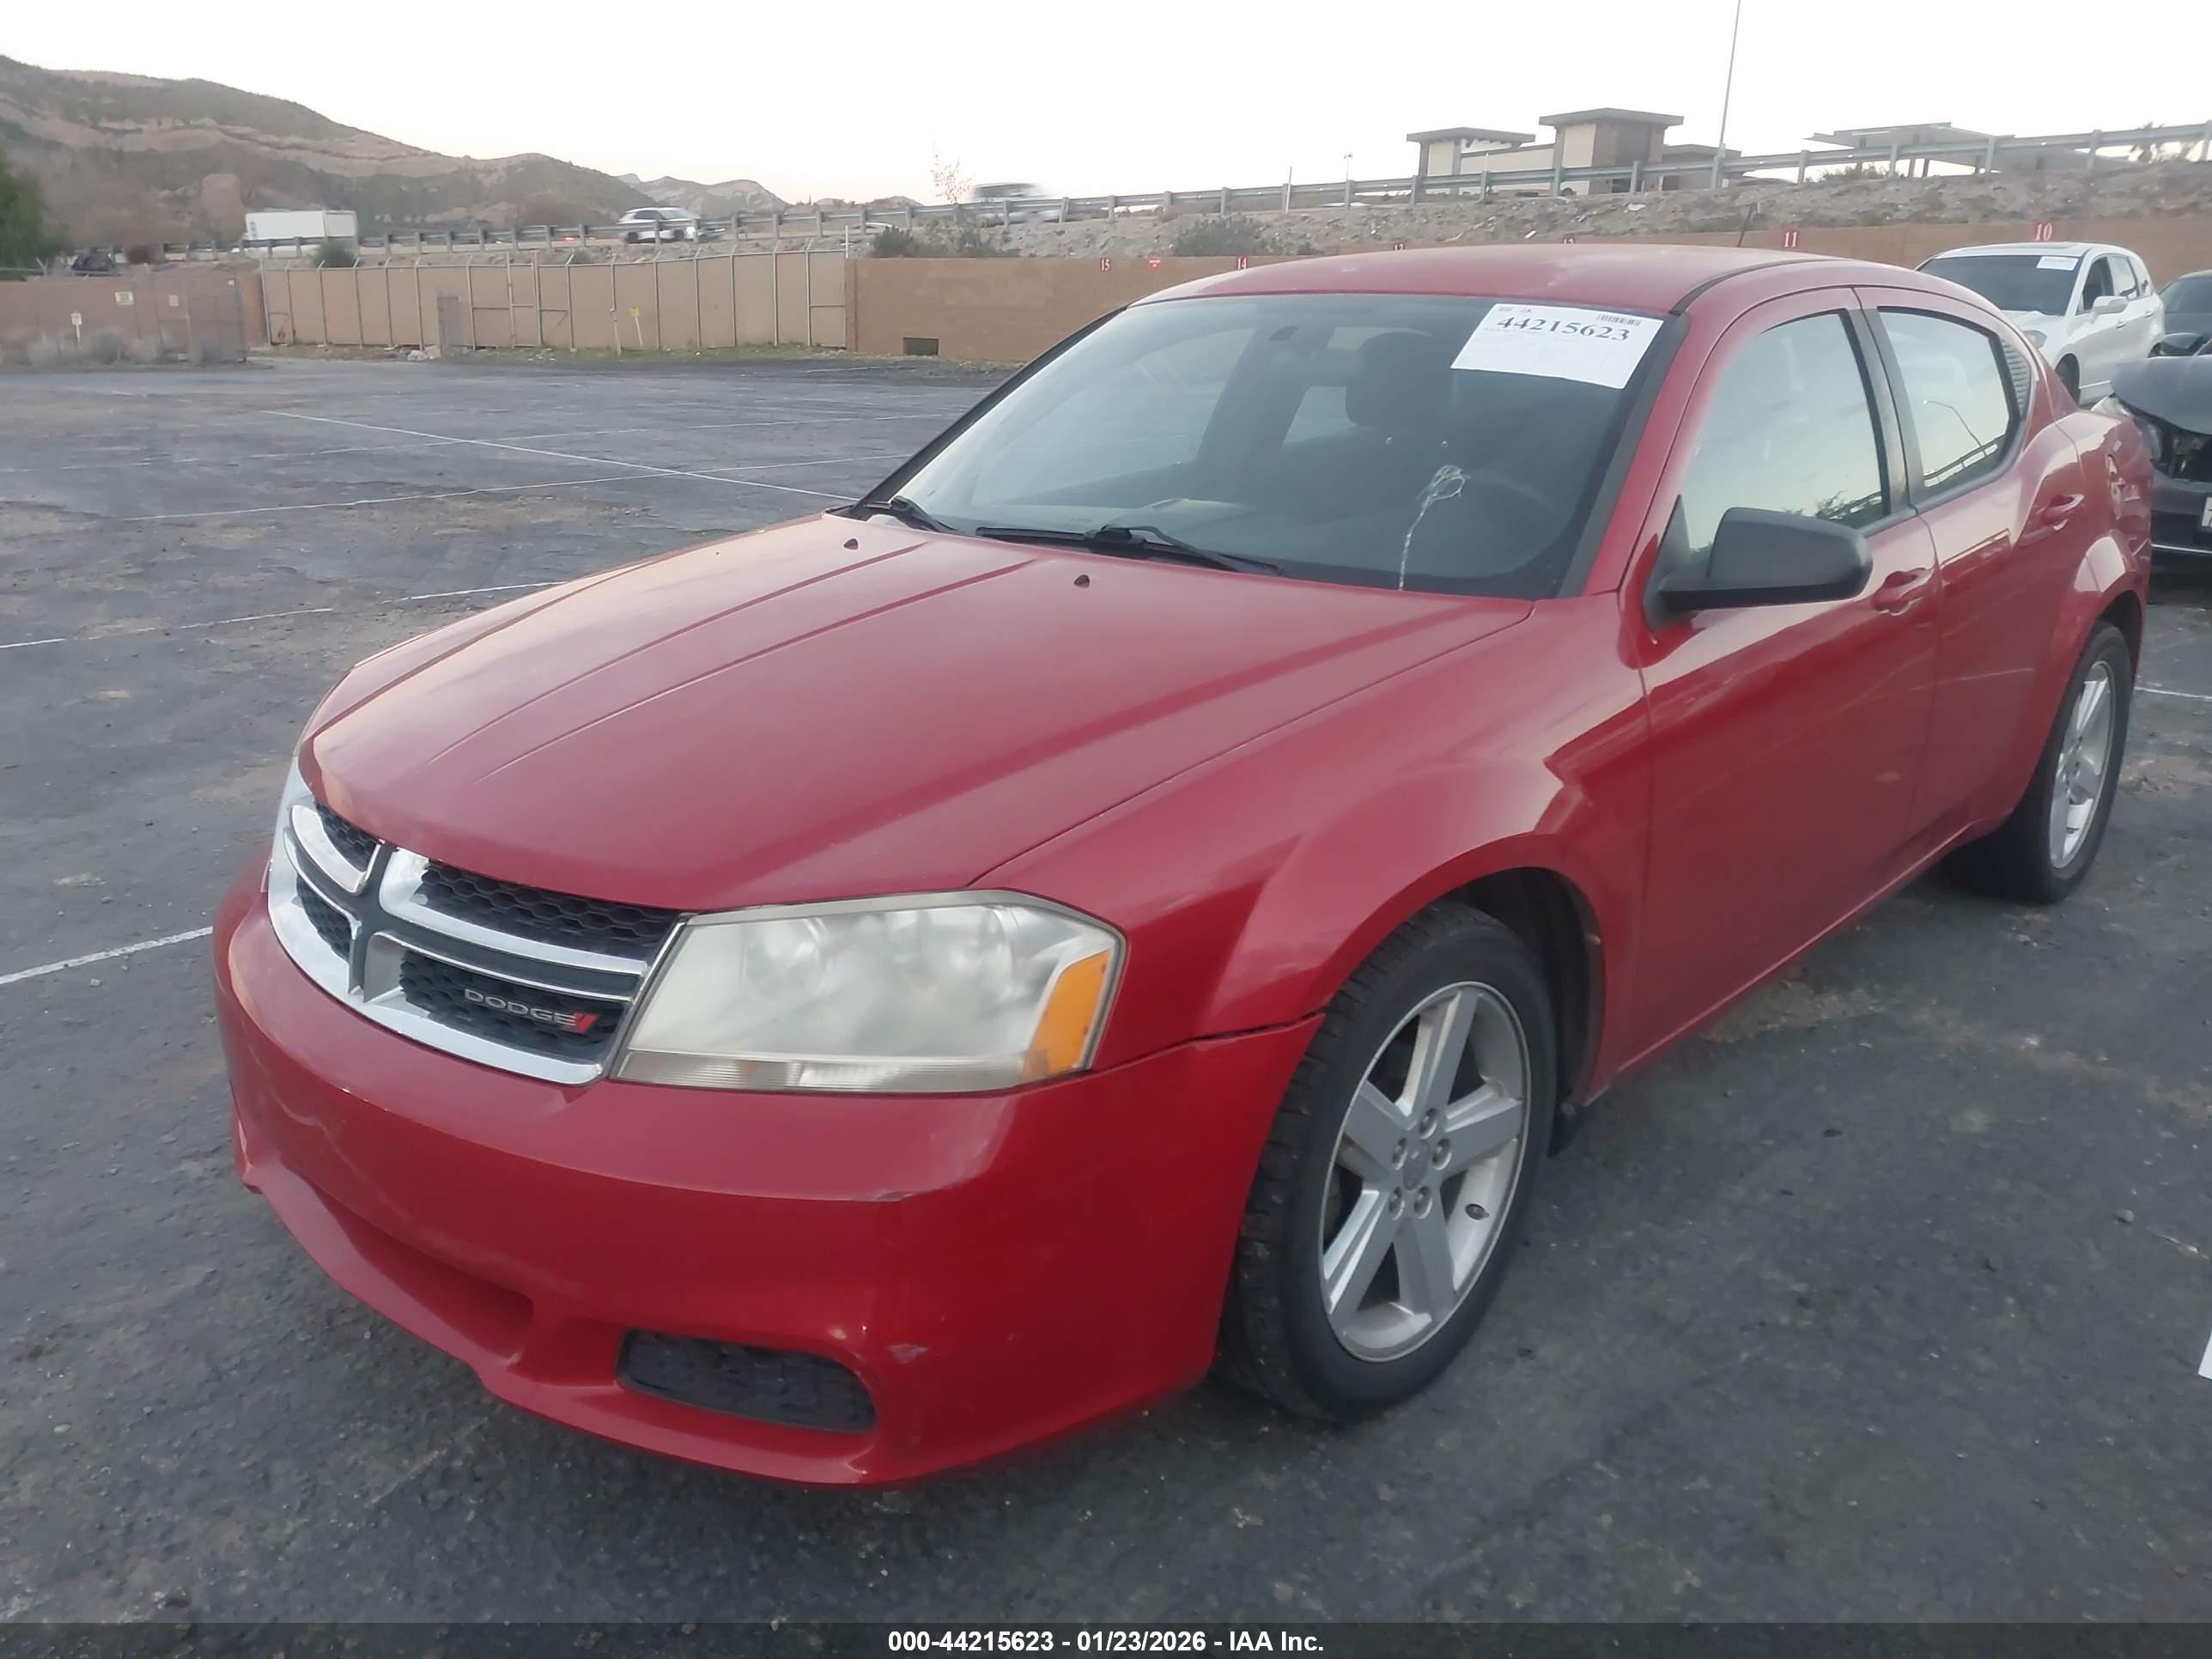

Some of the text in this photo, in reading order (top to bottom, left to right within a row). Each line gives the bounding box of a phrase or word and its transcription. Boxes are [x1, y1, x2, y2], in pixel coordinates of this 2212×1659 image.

[1784, 231, 1797, 248] 11
[2034, 222, 2053, 241] 10
[1100, 258, 1110, 271] 15
[1497, 316, 1632, 342] 44215623
[464, 988, 577, 1027] DODGE
